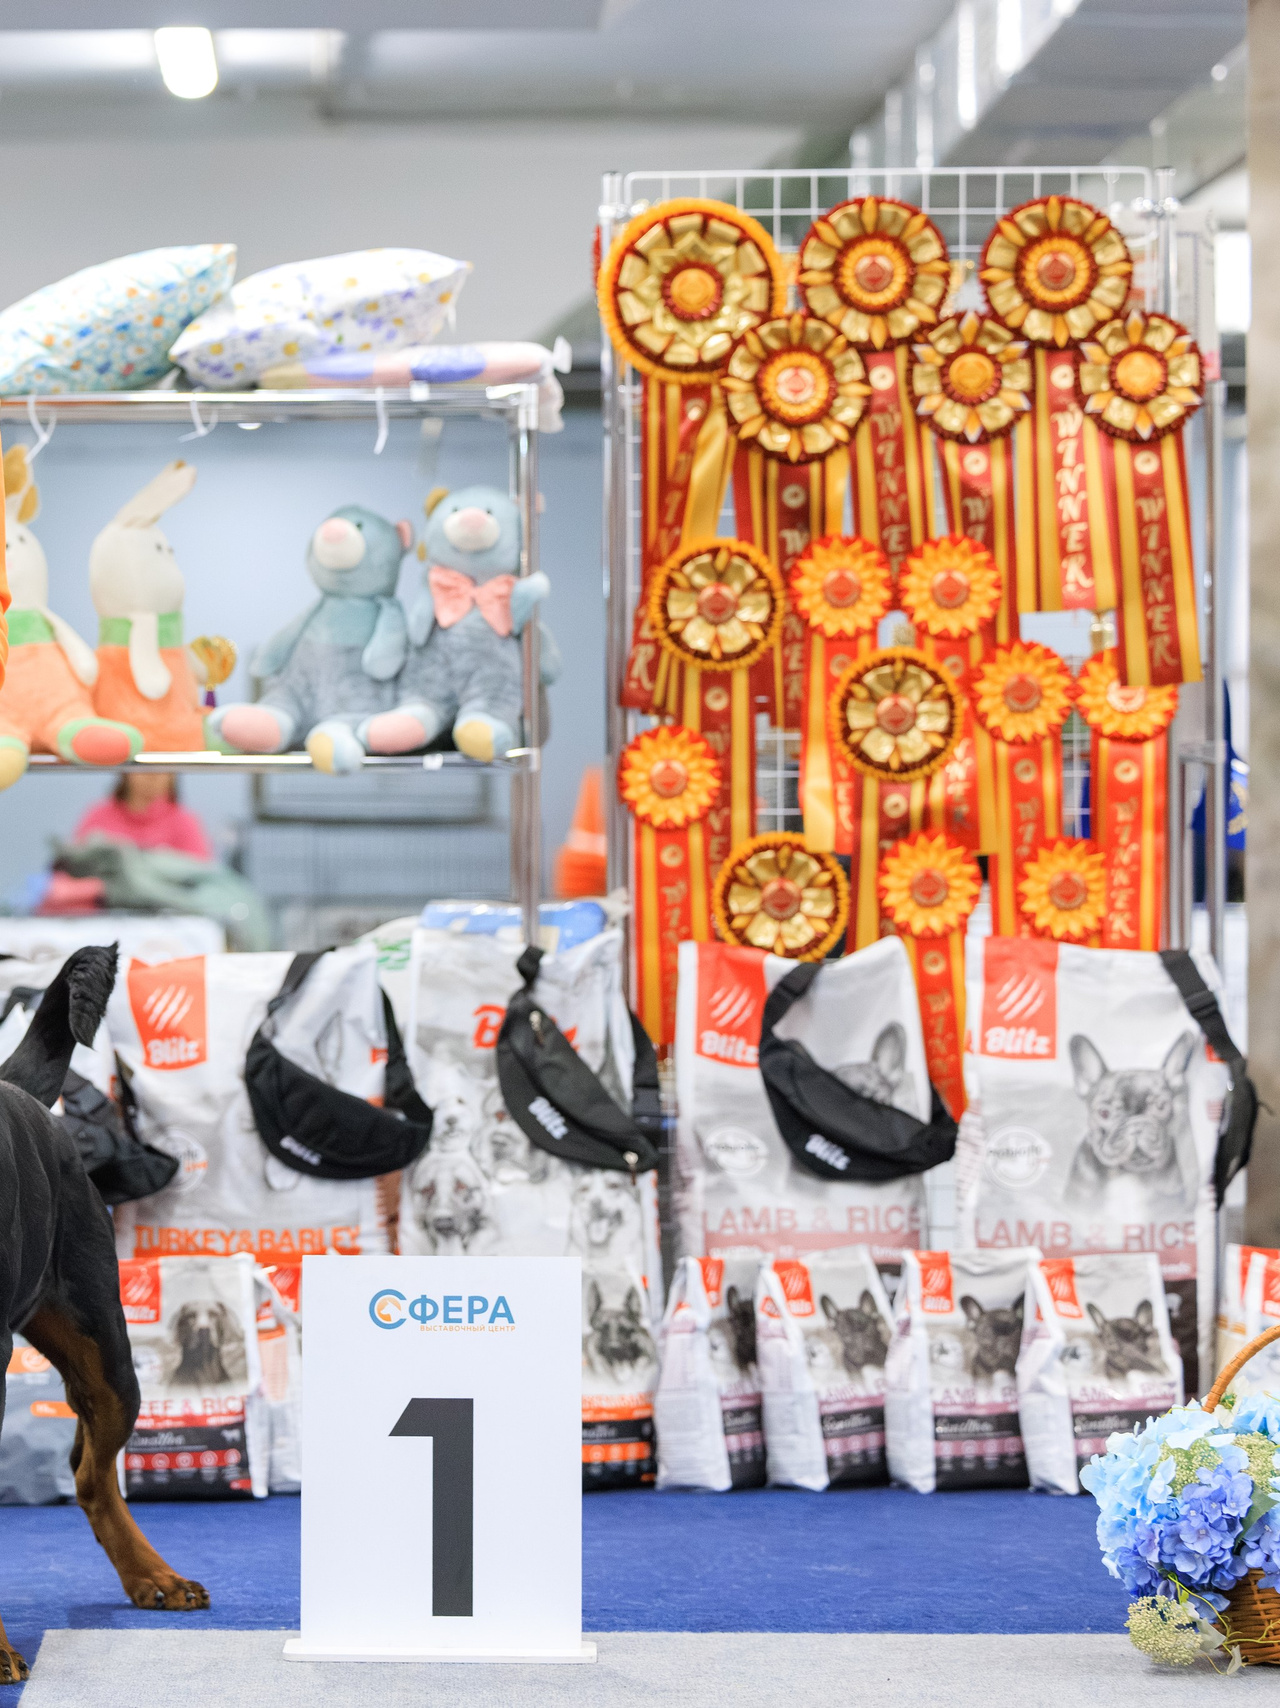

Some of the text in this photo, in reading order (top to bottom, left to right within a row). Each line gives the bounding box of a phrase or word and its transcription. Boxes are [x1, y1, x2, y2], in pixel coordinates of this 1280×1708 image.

[1050, 402, 1093, 589] WINNER
[146, 1037, 200, 1065] Blitz
[700, 1030, 759, 1064] Blitz
[984, 1026, 1050, 1055] Blitz
[804, 1133, 852, 1172] Blitz
[701, 1206, 798, 1234] LAMB
[975, 1218, 1072, 1249] LAMB
[368, 1288, 516, 1330] СФЕРА
[419, 1323, 516, 1334] ВЫСТАВОЧНЫЙ ЦЕНТР
[387, 1397, 475, 1618] 1
